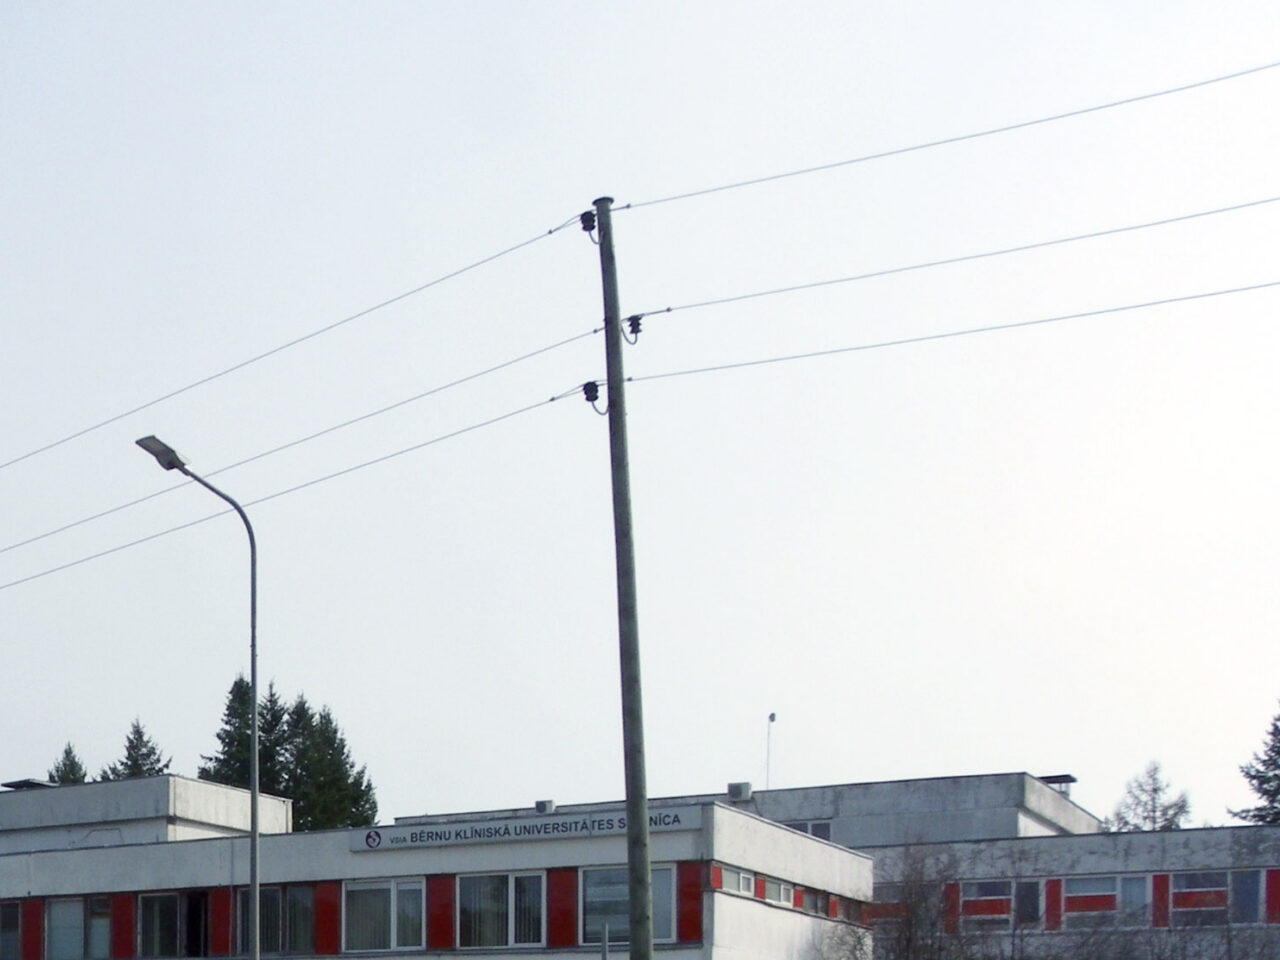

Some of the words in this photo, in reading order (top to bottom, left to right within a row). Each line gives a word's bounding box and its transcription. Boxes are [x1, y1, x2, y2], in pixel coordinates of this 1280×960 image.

[410, 830, 451, 843] BĒRNU
[455, 825, 511, 840] KLĪNISKĀ
[514, 818, 614, 836] UNIVERSITĀTES
[618, 814, 680, 829] SNĪCA
